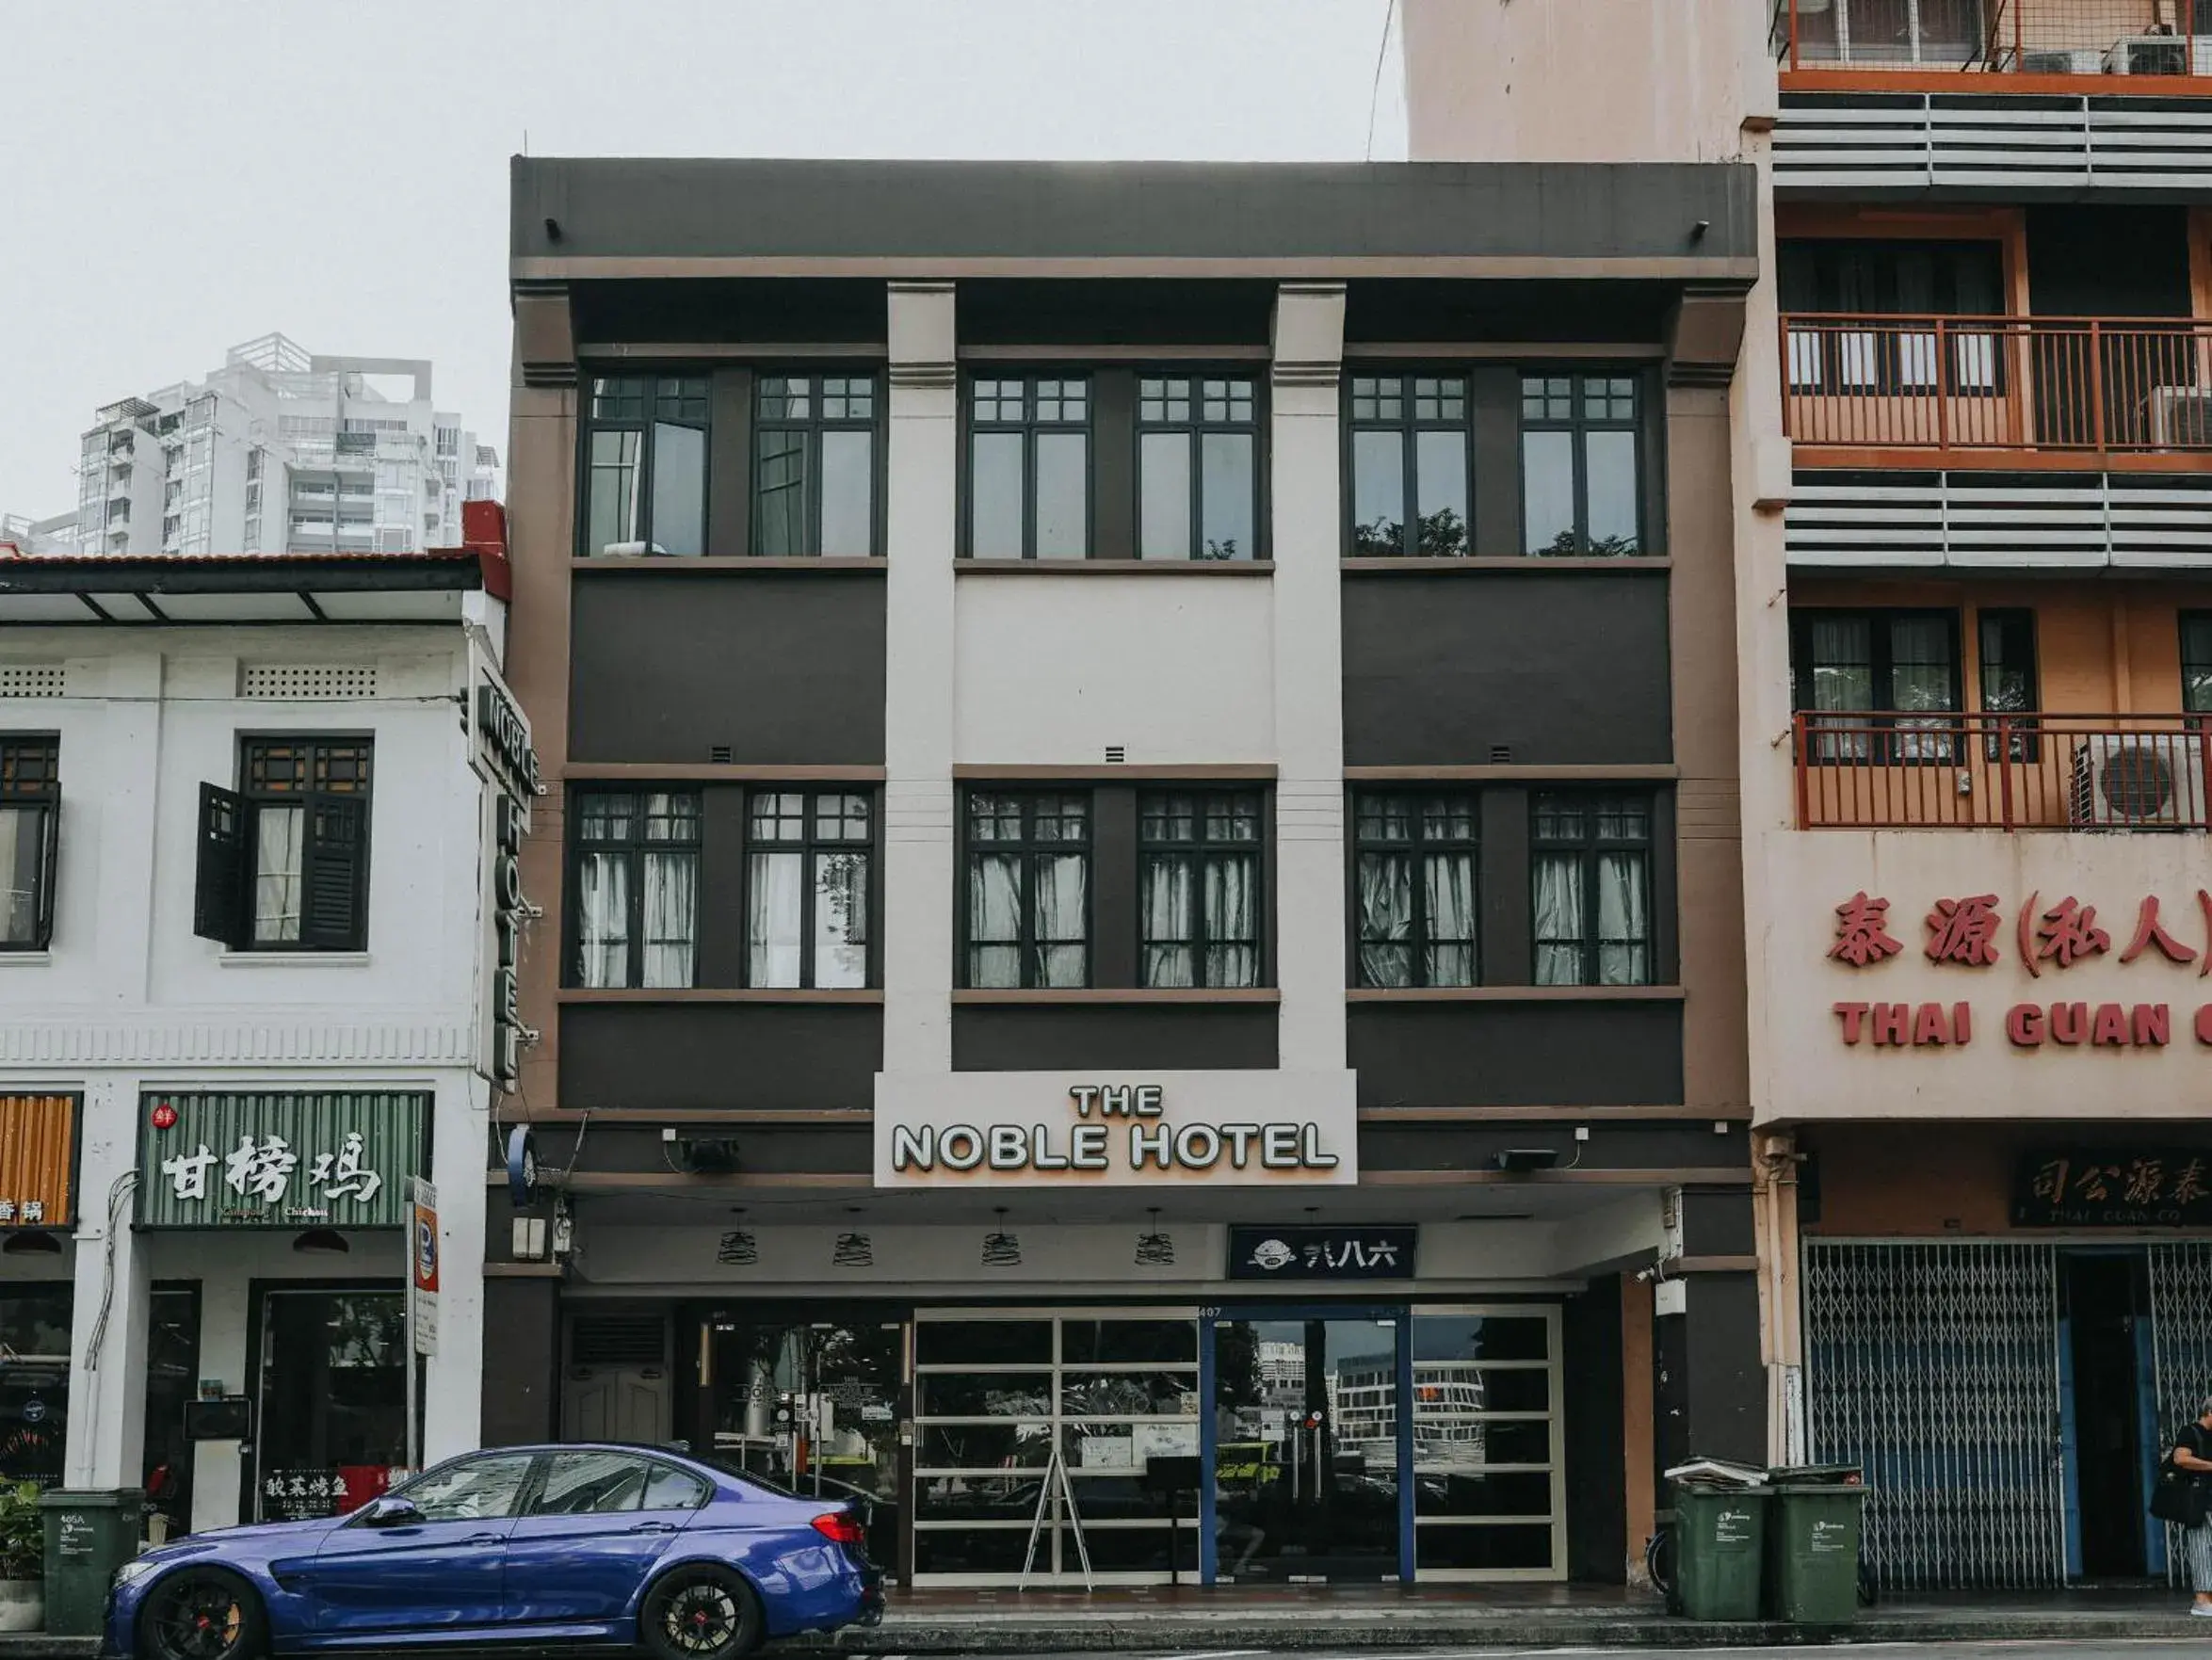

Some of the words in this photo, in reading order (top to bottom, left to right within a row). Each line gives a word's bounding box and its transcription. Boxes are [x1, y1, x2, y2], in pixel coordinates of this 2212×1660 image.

[478, 685, 540, 796] NOBLE
[494, 794, 520, 1079] HOTEL
[1834, 1001, 1972, 1045] THAI
[2007, 1002, 2170, 1047] GUAN
[1070, 1085, 1164, 1118] THE
[161, 1132, 382, 1203] 甘榜鸡
[892, 1124, 1109, 1171] NOBLE
[1130, 1122, 1340, 1170] HOTEL
